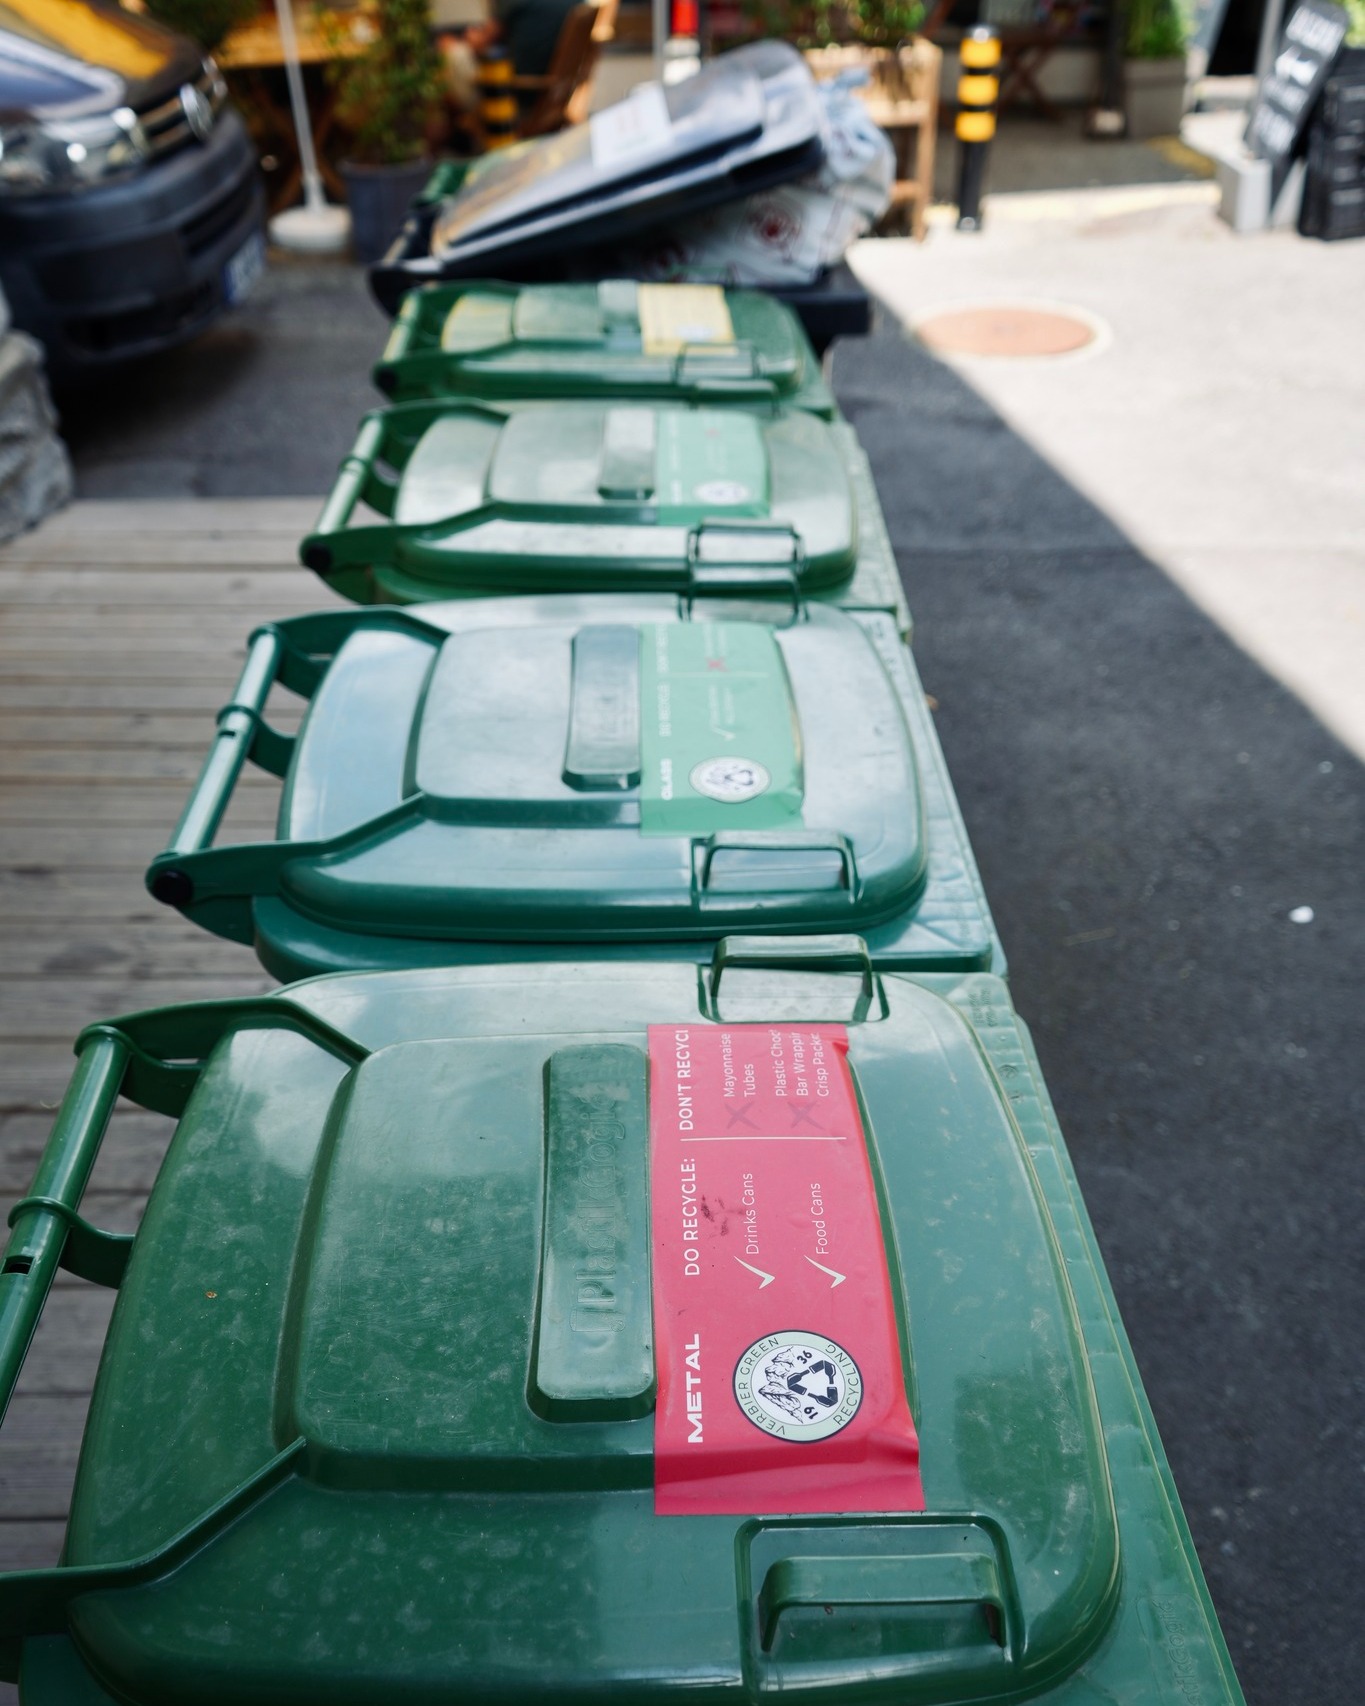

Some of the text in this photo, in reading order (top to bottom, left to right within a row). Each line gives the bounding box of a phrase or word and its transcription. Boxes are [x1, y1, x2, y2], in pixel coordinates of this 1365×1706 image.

[720, 1033, 737, 1097] Mayonnaise
[743, 1063, 756, 1097] Tubes
[772, 1060, 788, 1096] Plastic
[796, 1077, 808, 1096] Bar
[815, 1068, 829, 1097] Crisp
[677, 1084, 694, 1130] DON'T
[680, 1158, 700, 1276] DO RECYCLE:
[741, 1173, 759, 1255] Drinks Cans
[810, 1183, 829, 1255] Food Cans
[685, 1333, 704, 1443] METAL
[738, 1337, 785, 1435] VERBIER GREEN
[825, 1344, 860, 1425] RECYCLING
